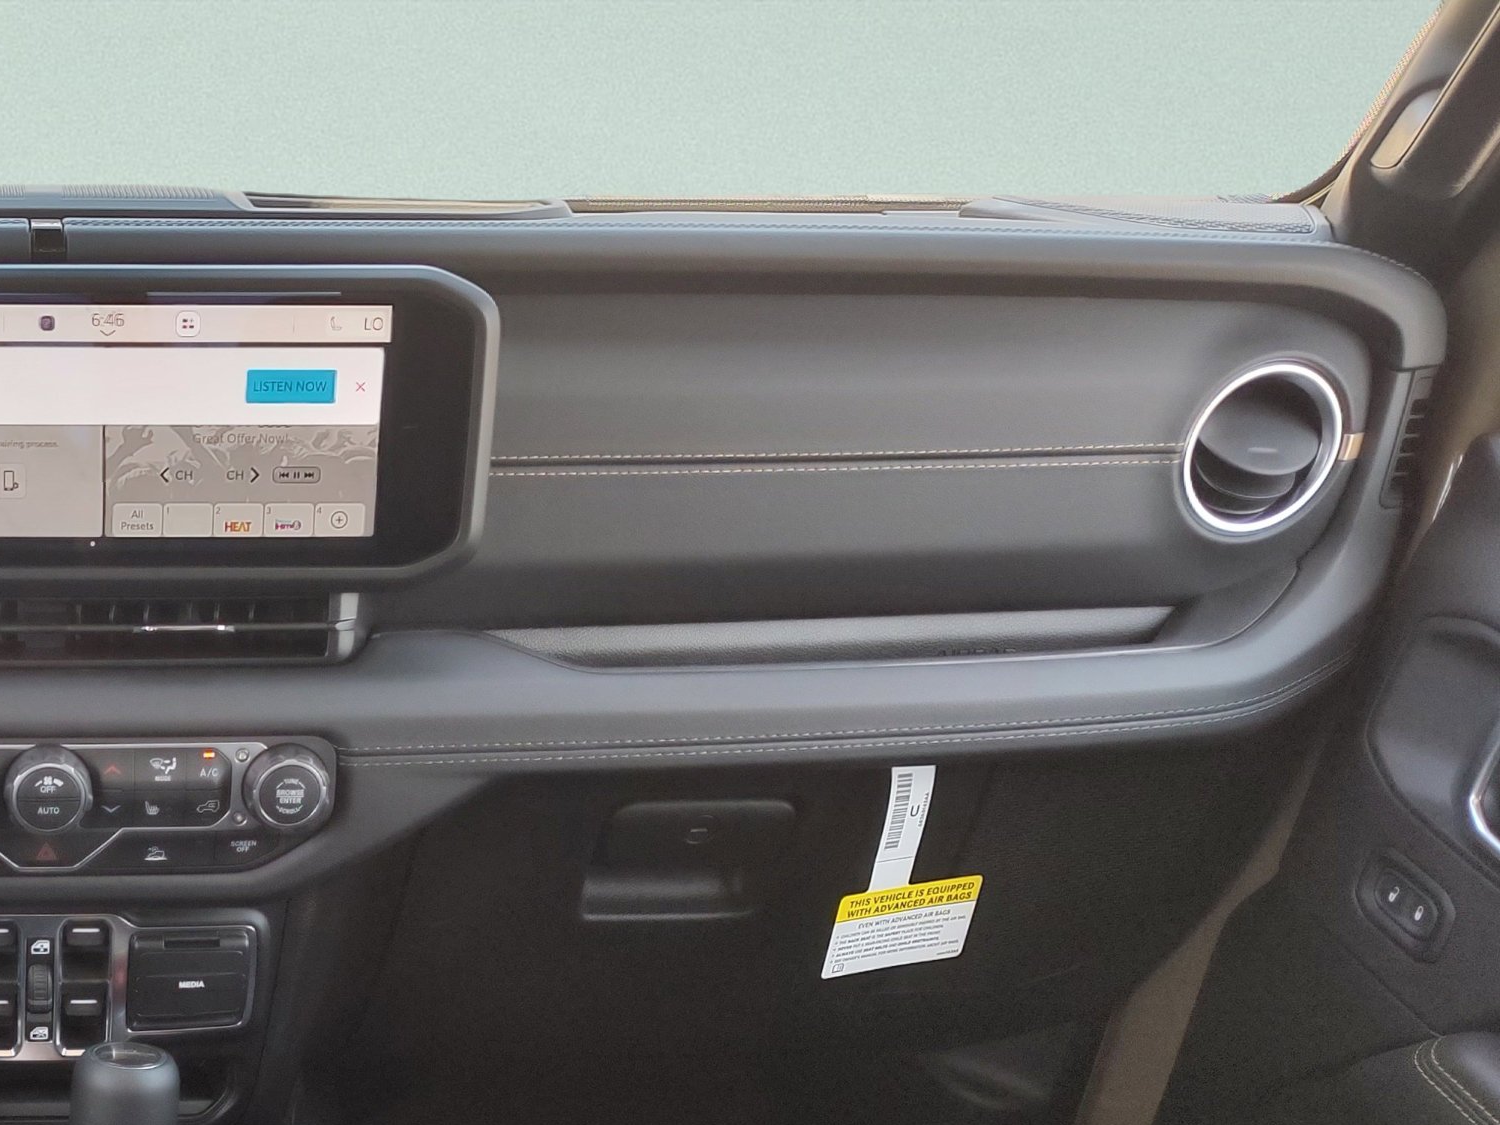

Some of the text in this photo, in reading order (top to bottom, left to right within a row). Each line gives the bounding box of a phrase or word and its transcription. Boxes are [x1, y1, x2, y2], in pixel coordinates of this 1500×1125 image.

[91, 312, 125, 328] 6:46
[364, 317, 384, 331] LO
[253, 380, 327, 392] LISTEN NOW
[193, 433, 223, 444] Great
[226, 433, 255, 444] Offer
[175, 469, 194, 481] CH
[226, 469, 245, 481] CH
[131, 509, 143, 519] All
[215, 507, 221, 515] 2
[266, 507, 272, 515] 3
[316, 506, 322, 514] 4
[120, 521, 154, 531] Presets
[224, 521, 252, 532] HEAT
[200, 768, 219, 777] A/C
[40, 786, 56, 794] OFF
[37, 806, 60, 815] AUTO
[910, 804, 920, 818] U
[850, 881, 975, 909] THIS VEHICLE IS EQUIPPED
[847, 891, 972, 919] WITH ADVANCED AIR BAGS
[891, 913, 923, 923] ADVANCED
[178, 980, 206, 989] MEDIA
